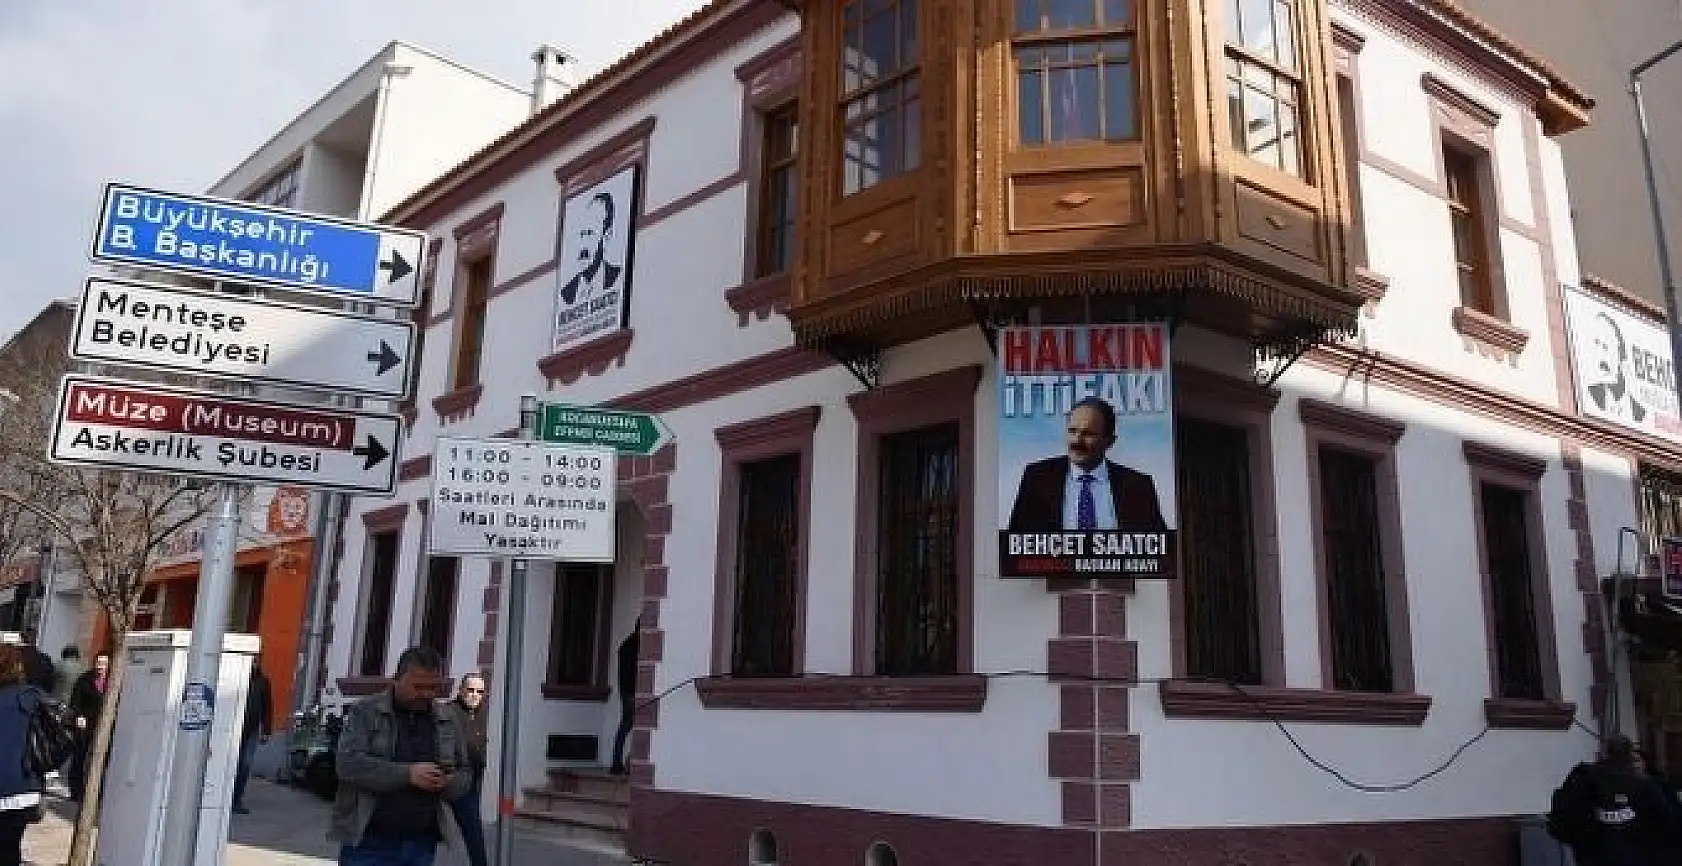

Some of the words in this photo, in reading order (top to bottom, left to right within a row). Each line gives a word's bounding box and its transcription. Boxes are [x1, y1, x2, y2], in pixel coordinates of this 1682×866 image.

[116, 195, 314, 246] Büyükşehir
[111, 224, 135, 249] B.
[155, 226, 329, 283] Başkanlığı
[98, 291, 247, 332] Menteşe
[91, 321, 271, 365] Belediyesi
[1004, 327, 1164, 373] HALKIN
[76, 390, 168, 422] Müze
[181, 403, 343, 446] (Museum)
[70, 427, 203, 460] Askerlik
[217, 442, 321, 473] Şubesi
[451, 448, 511, 464] 11:00
[545, 455, 602, 471] 14:00
[439, 487, 515, 506] Saatleri
[524, 493, 607, 512] Arasında
[449, 468, 511, 485] 16:00
[541, 474, 602, 491] 09:00
[459, 510, 495, 526] Mal
[505, 511, 588, 533] Dağıtımı
[484, 531, 562, 550] Yasaktır
[1008, 533, 1087, 558] BEHÇET
[1092, 533, 1168, 555] SAATCI
